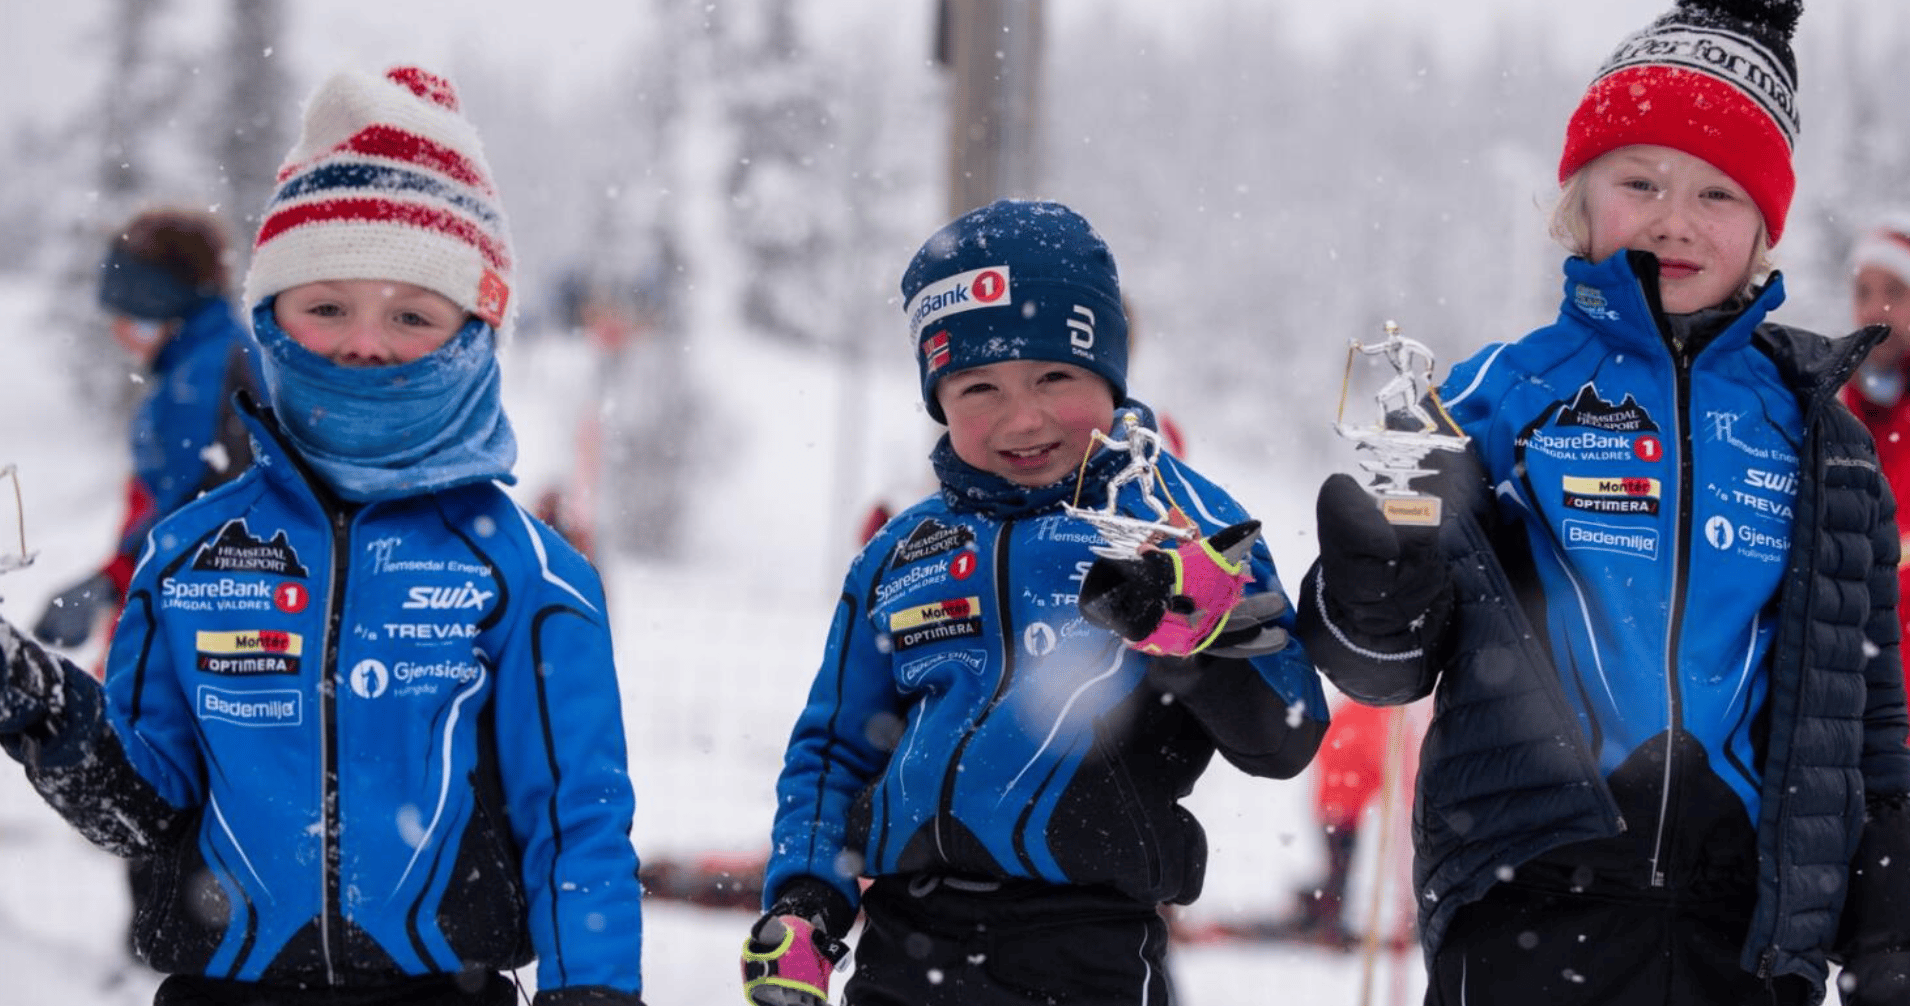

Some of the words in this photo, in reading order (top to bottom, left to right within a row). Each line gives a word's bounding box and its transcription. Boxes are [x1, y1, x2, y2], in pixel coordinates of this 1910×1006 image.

[1532, 428, 1630, 450] SpareBank
[1581, 451, 1631, 461] VALDRES
[1574, 498, 1650, 512] OPTIMERA
[1732, 490, 1794, 519] TREVA
[218, 547, 287, 560] HEMSEDAL
[214, 557, 287, 572] FJELLSPORT
[162, 577, 271, 599] SpareBank
[875, 560, 949, 602] SpareBank
[161, 599, 214, 611] LINGDAL
[217, 600, 271, 611] VALDRES
[904, 623, 975, 646] OPTIMERA
[208, 657, 287, 672] OPTIMERA
[205, 694, 295, 719] Bademiljø
